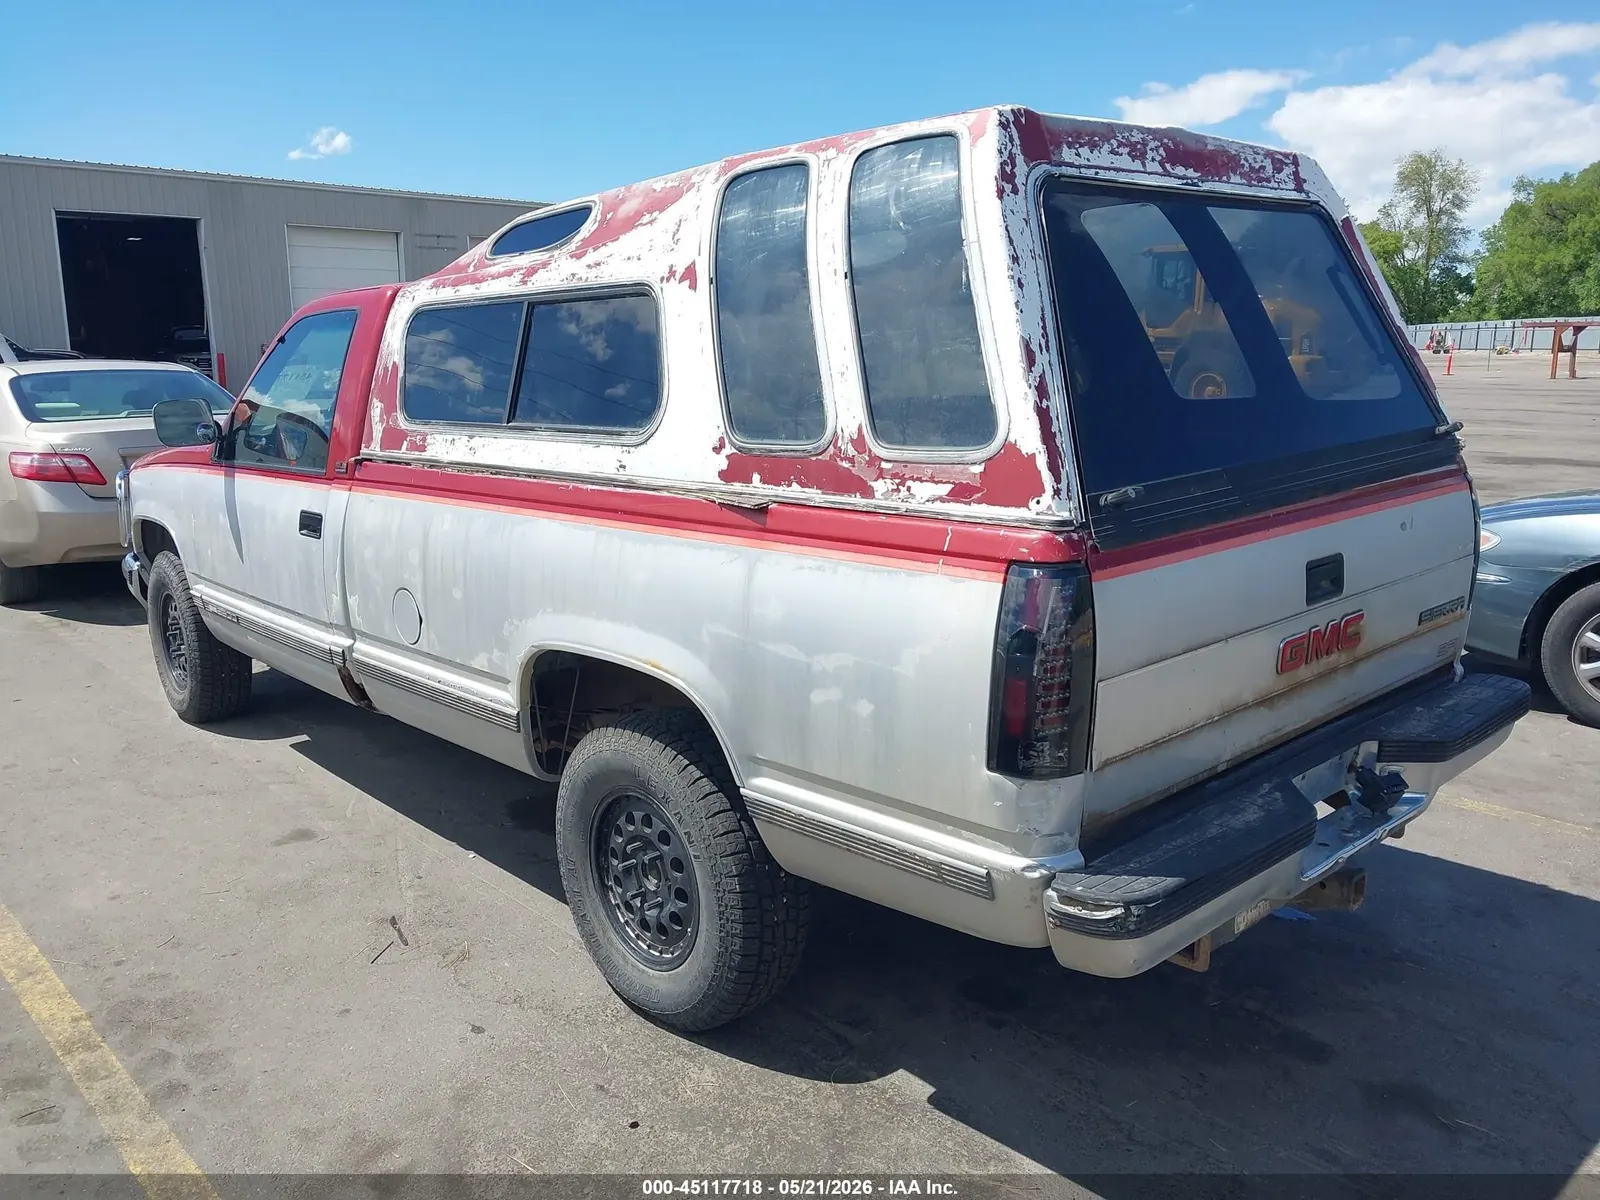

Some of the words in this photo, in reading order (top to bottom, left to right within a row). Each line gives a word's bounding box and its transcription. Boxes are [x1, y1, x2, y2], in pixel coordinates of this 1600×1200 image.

[1418, 596, 1465, 626] SIERRA
[1276, 608, 1365, 675] GMC
[632, 763, 702, 863] LEXANI
[600, 954, 661, 1004] TERRAIN
